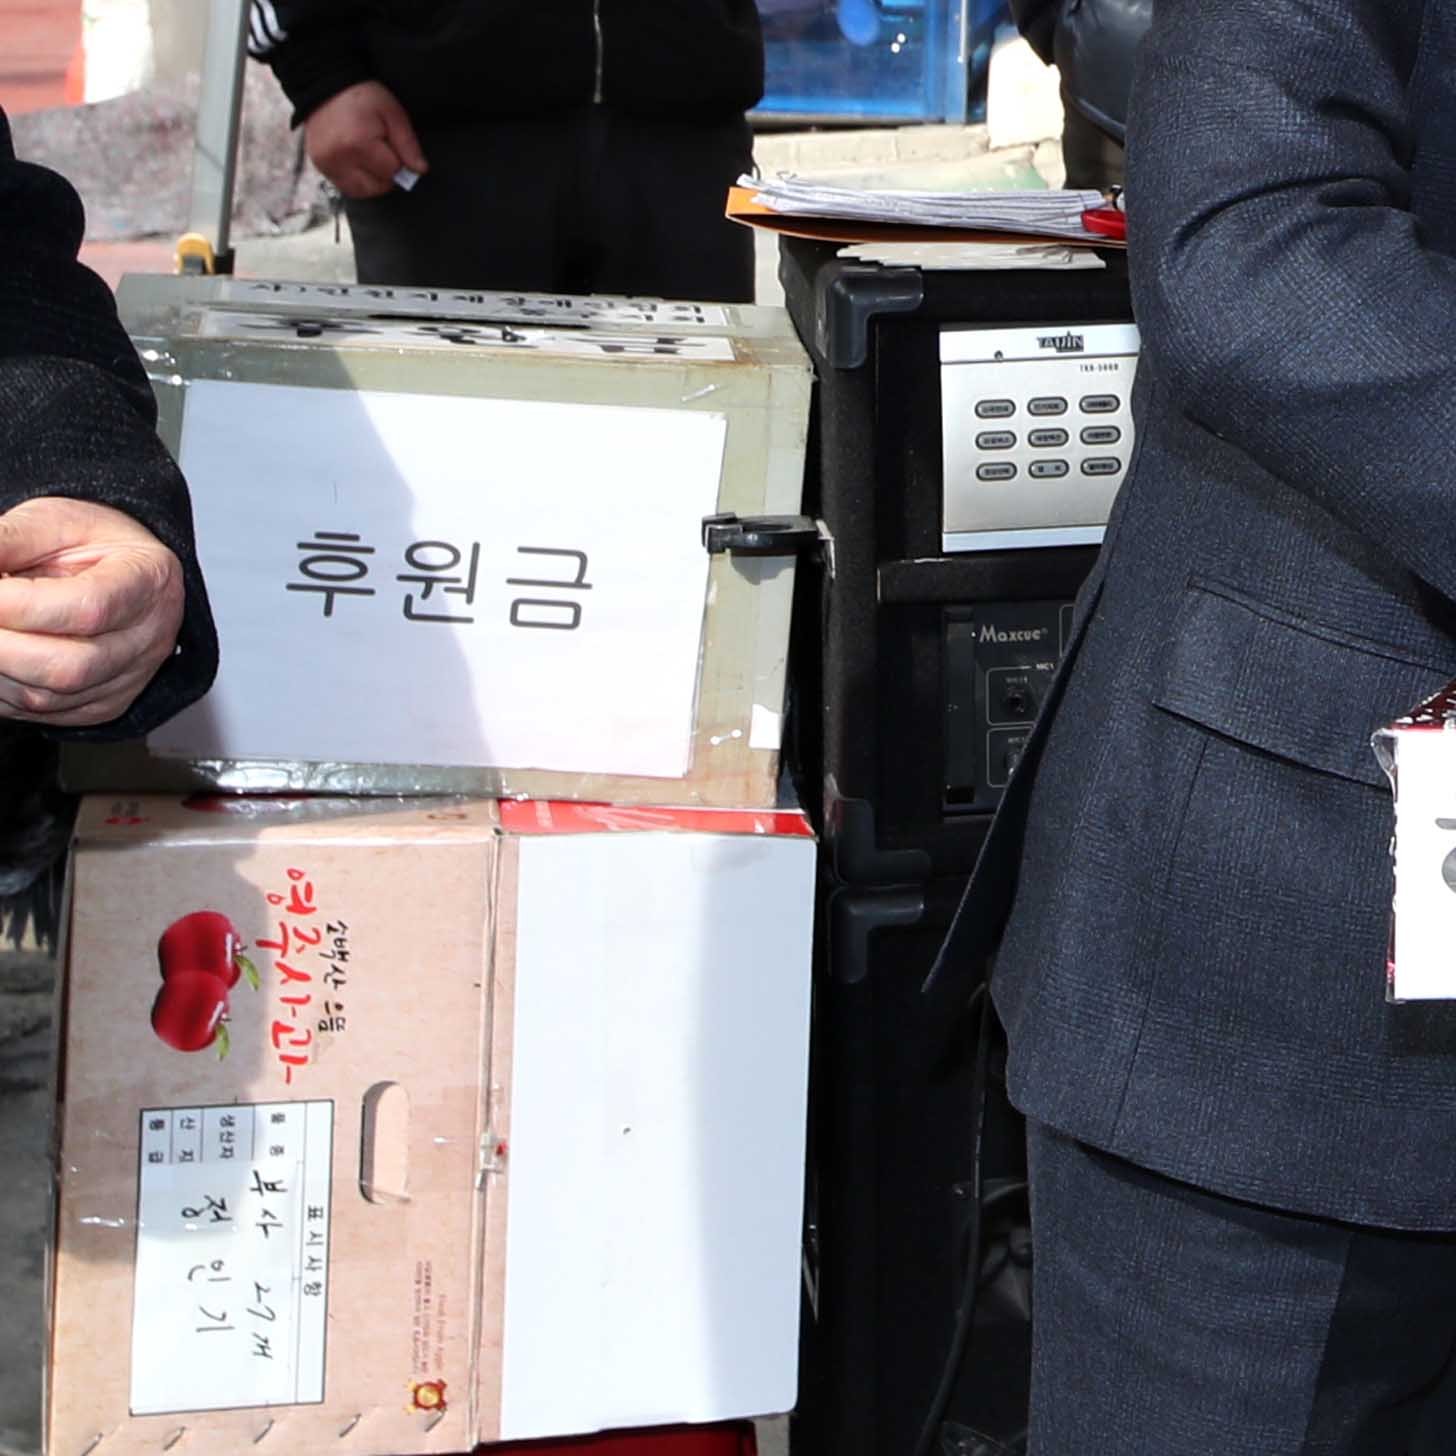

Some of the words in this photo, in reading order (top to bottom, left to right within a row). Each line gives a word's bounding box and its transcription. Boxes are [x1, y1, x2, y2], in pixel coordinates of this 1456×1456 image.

[286, 530, 593, 630] 후원금
[255, 867, 322, 1085] 영주사과
[319, 920, 350, 991] 소백산
